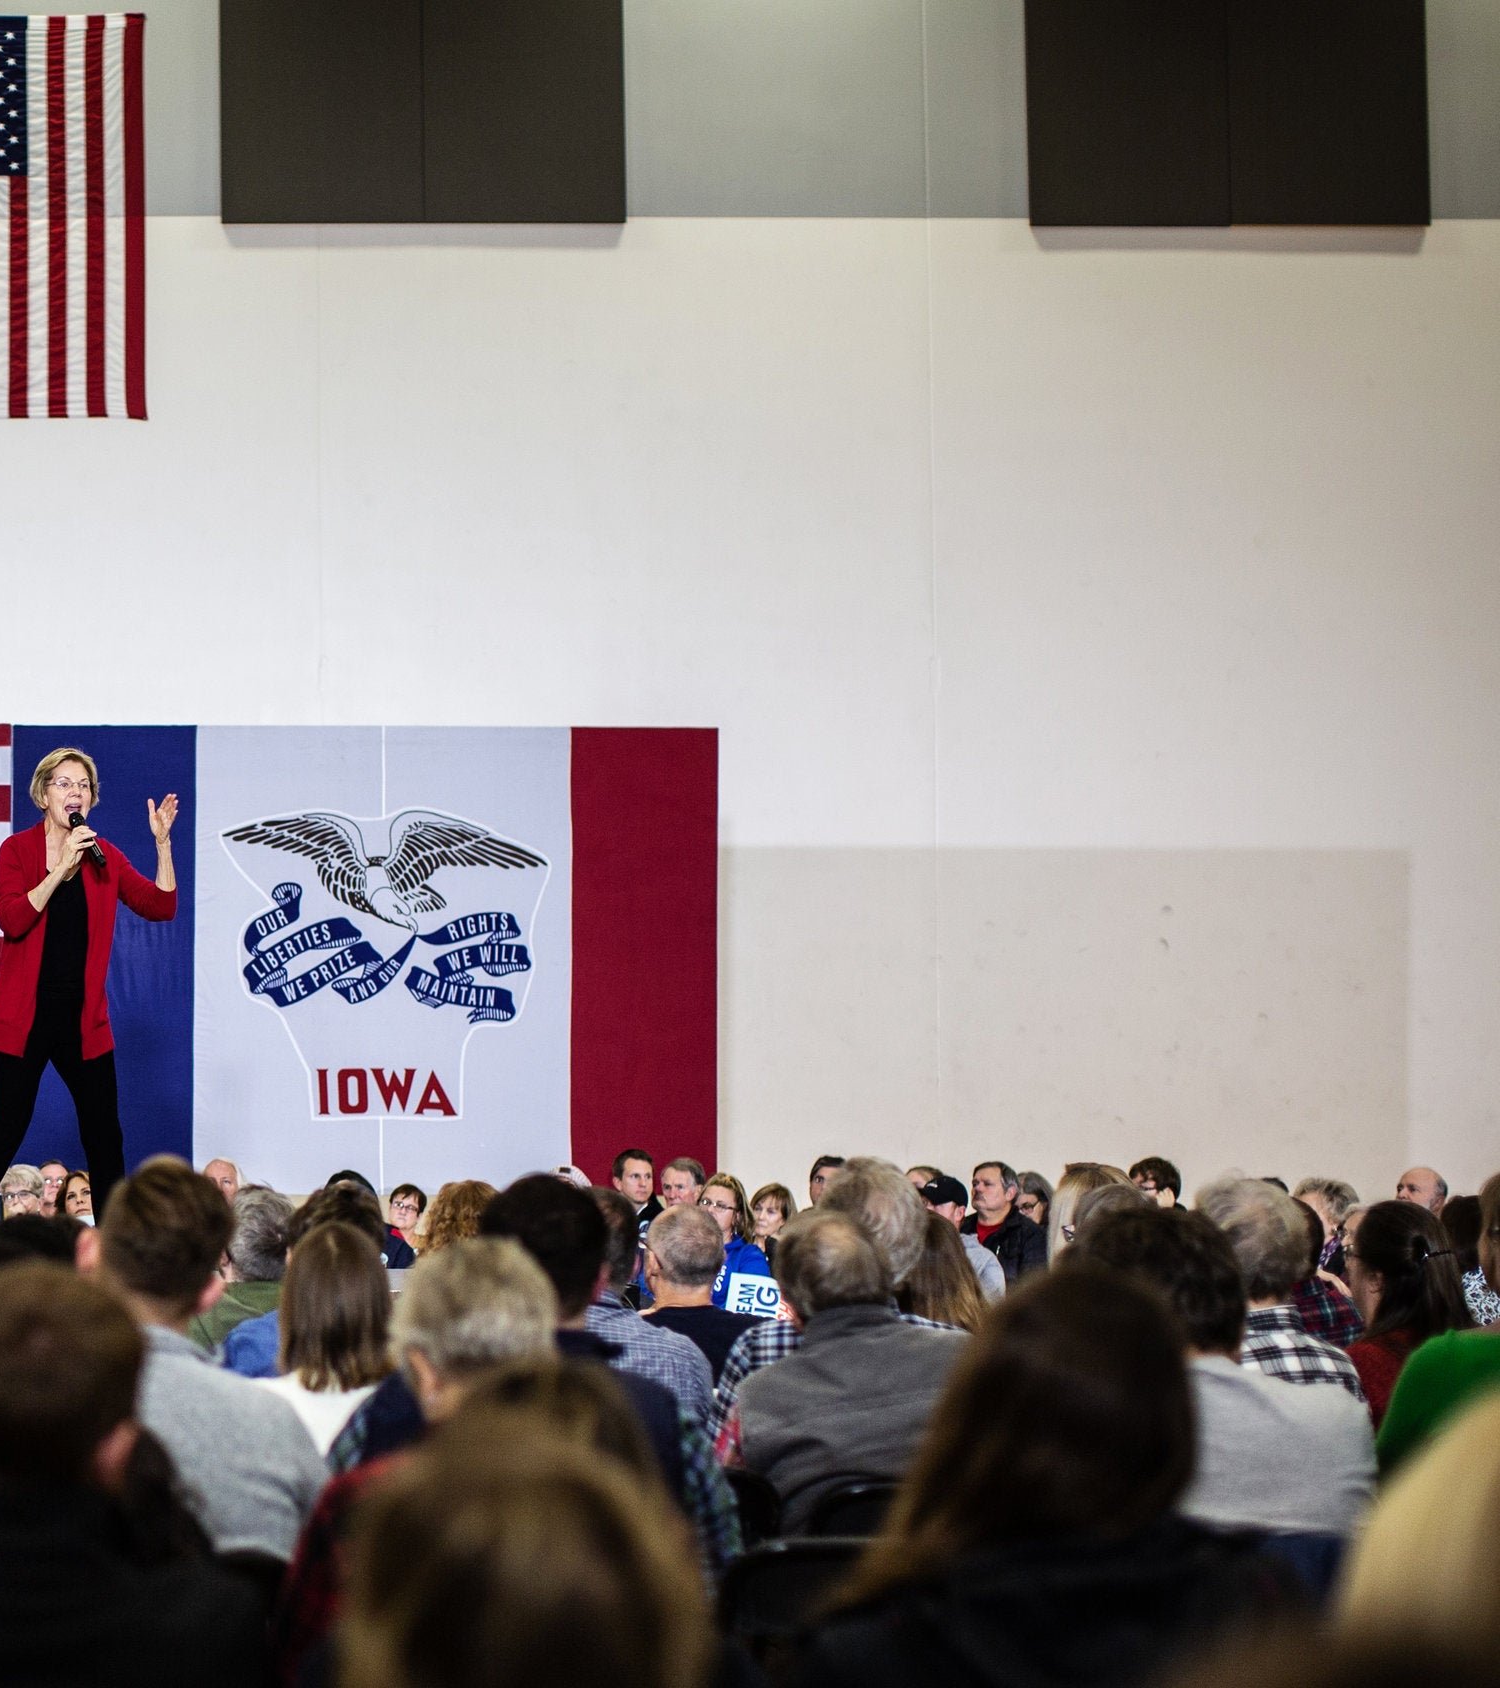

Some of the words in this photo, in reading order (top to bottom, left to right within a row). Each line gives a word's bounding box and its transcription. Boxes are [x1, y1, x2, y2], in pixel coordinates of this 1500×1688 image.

[255, 909, 288, 937] OUR
[446, 912, 509, 941] RIGHTS
[251, 923, 332, 979] LIBERTIES
[446, 948, 472, 972] WE
[479, 944, 518, 964] WILL
[281, 978, 308, 1002] WE
[309, 949, 356, 988] PRIZE
[348, 981, 378, 1003] AND
[378, 958, 401, 983] OUR
[416, 972, 496, 1007] MAINTAIN
[316, 1067, 458, 1117] IOWA
[736, 1283, 757, 1314] EAM
[754, 1285, 780, 1316] IG
